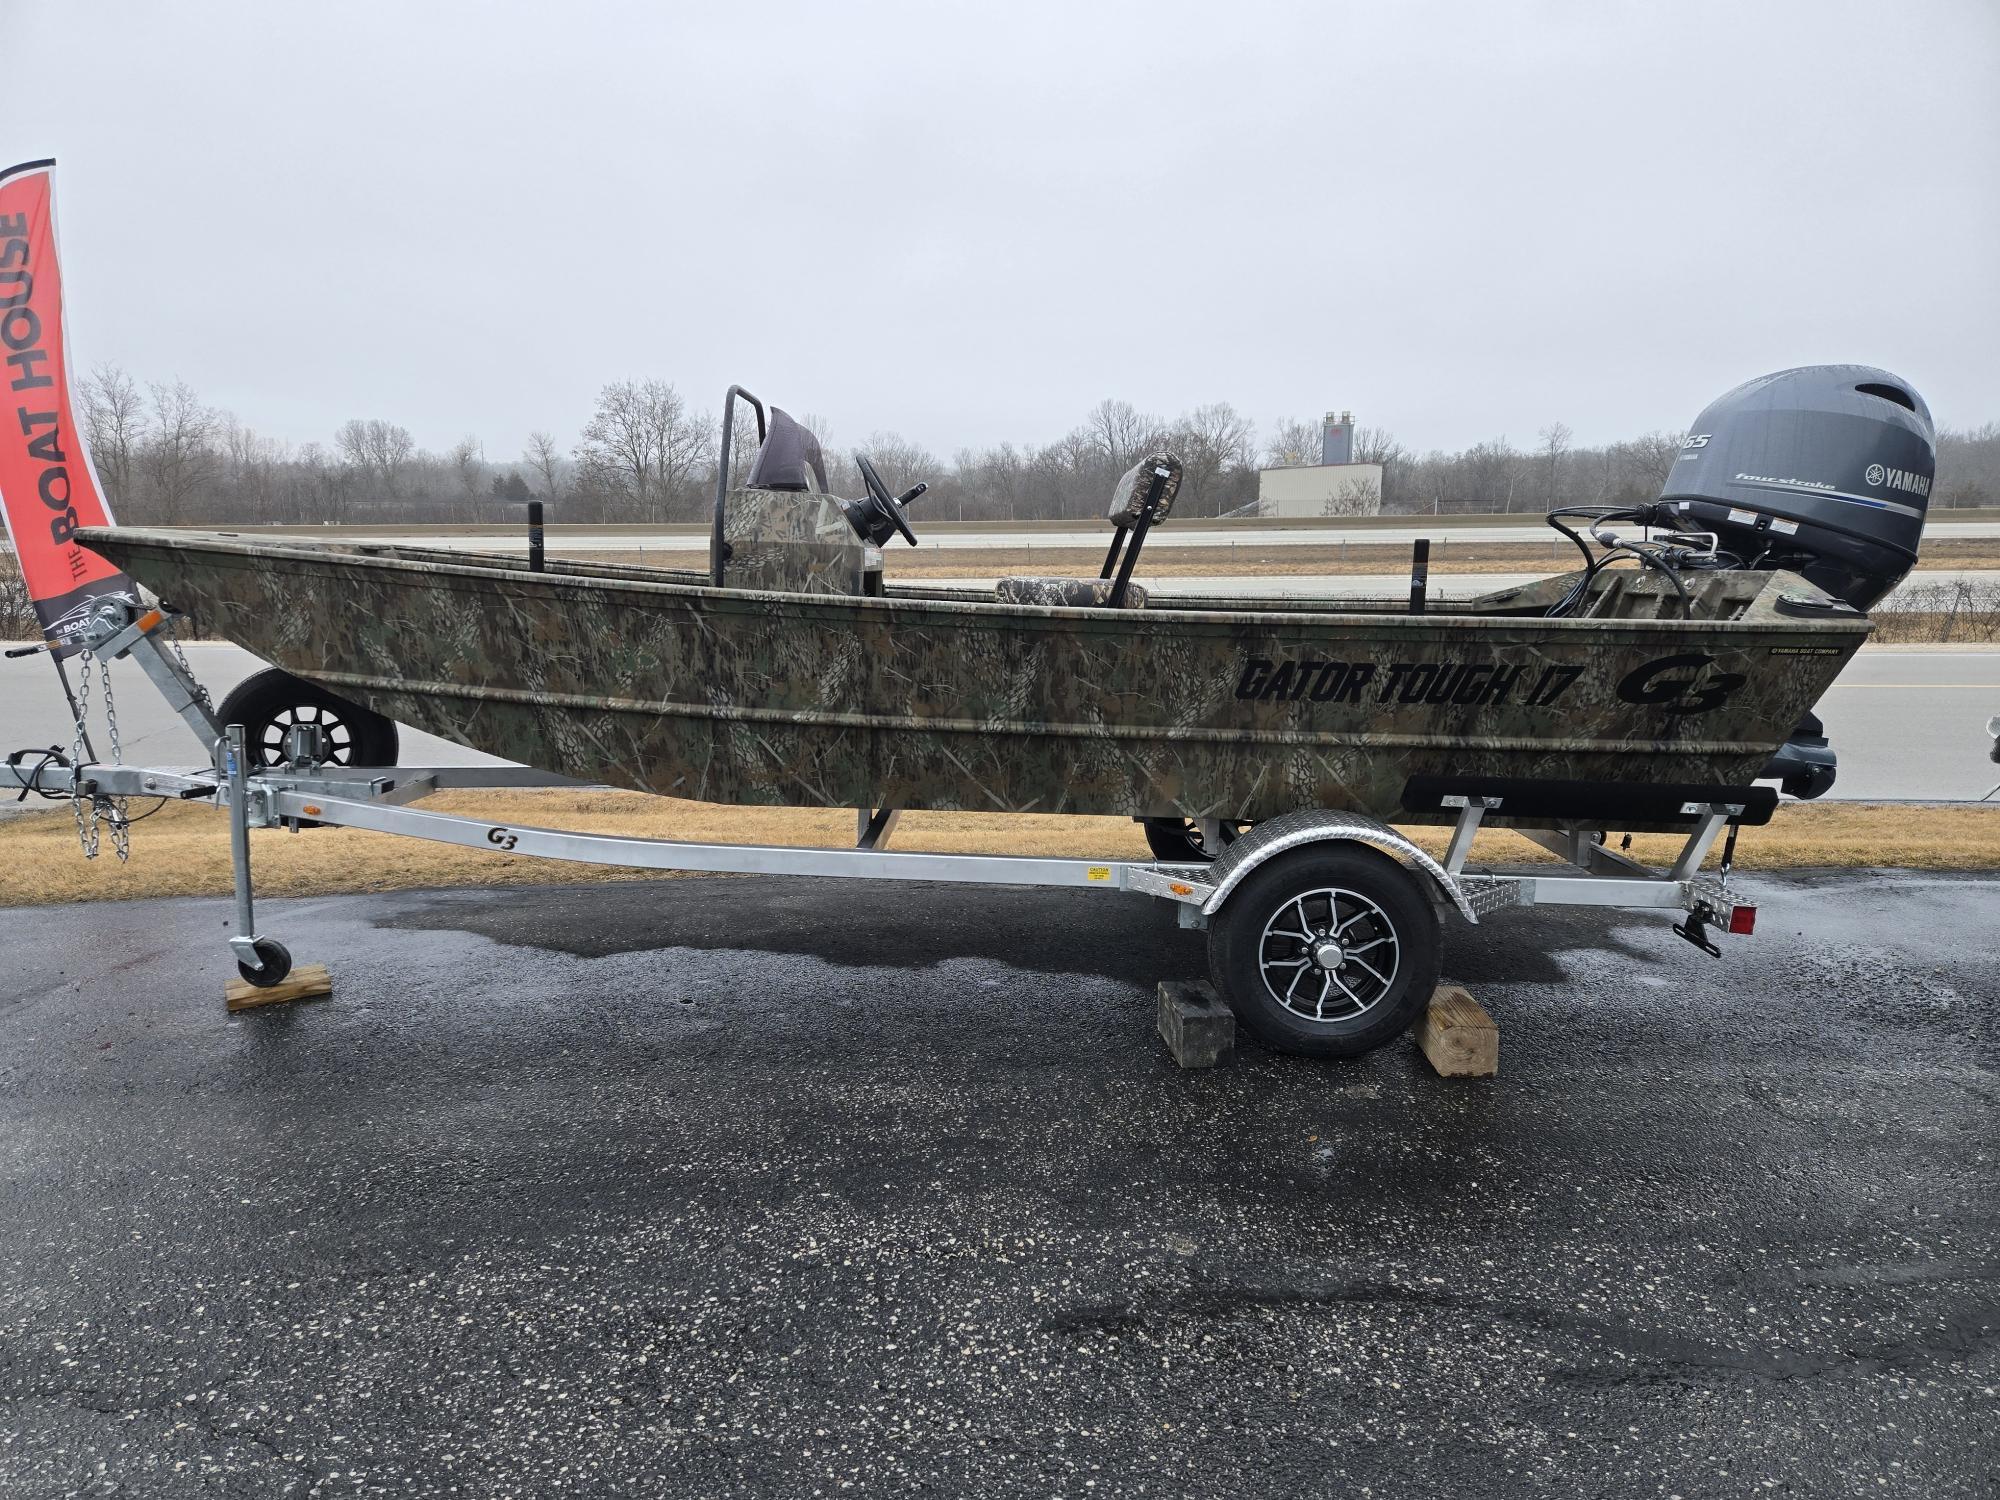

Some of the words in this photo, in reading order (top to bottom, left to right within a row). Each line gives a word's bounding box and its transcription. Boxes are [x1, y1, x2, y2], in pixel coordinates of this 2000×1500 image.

[0, 212, 54, 392] HOUSE
[1683, 434, 1713, 449] 65
[18, 406, 80, 545] BOAT
[1735, 472, 1836, 491] fourstroke
[1886, 467, 1930, 497] YAMAHA
[68, 545, 88, 582] THE
[63, 617, 91, 634] BOAT
[1234, 660, 1377, 702] GATOR
[1377, 664, 1525, 704] TOUGH
[1524, 665, 1587, 706] 17
[1616, 654, 1748, 715] G3
[488, 827, 518, 850] G3
